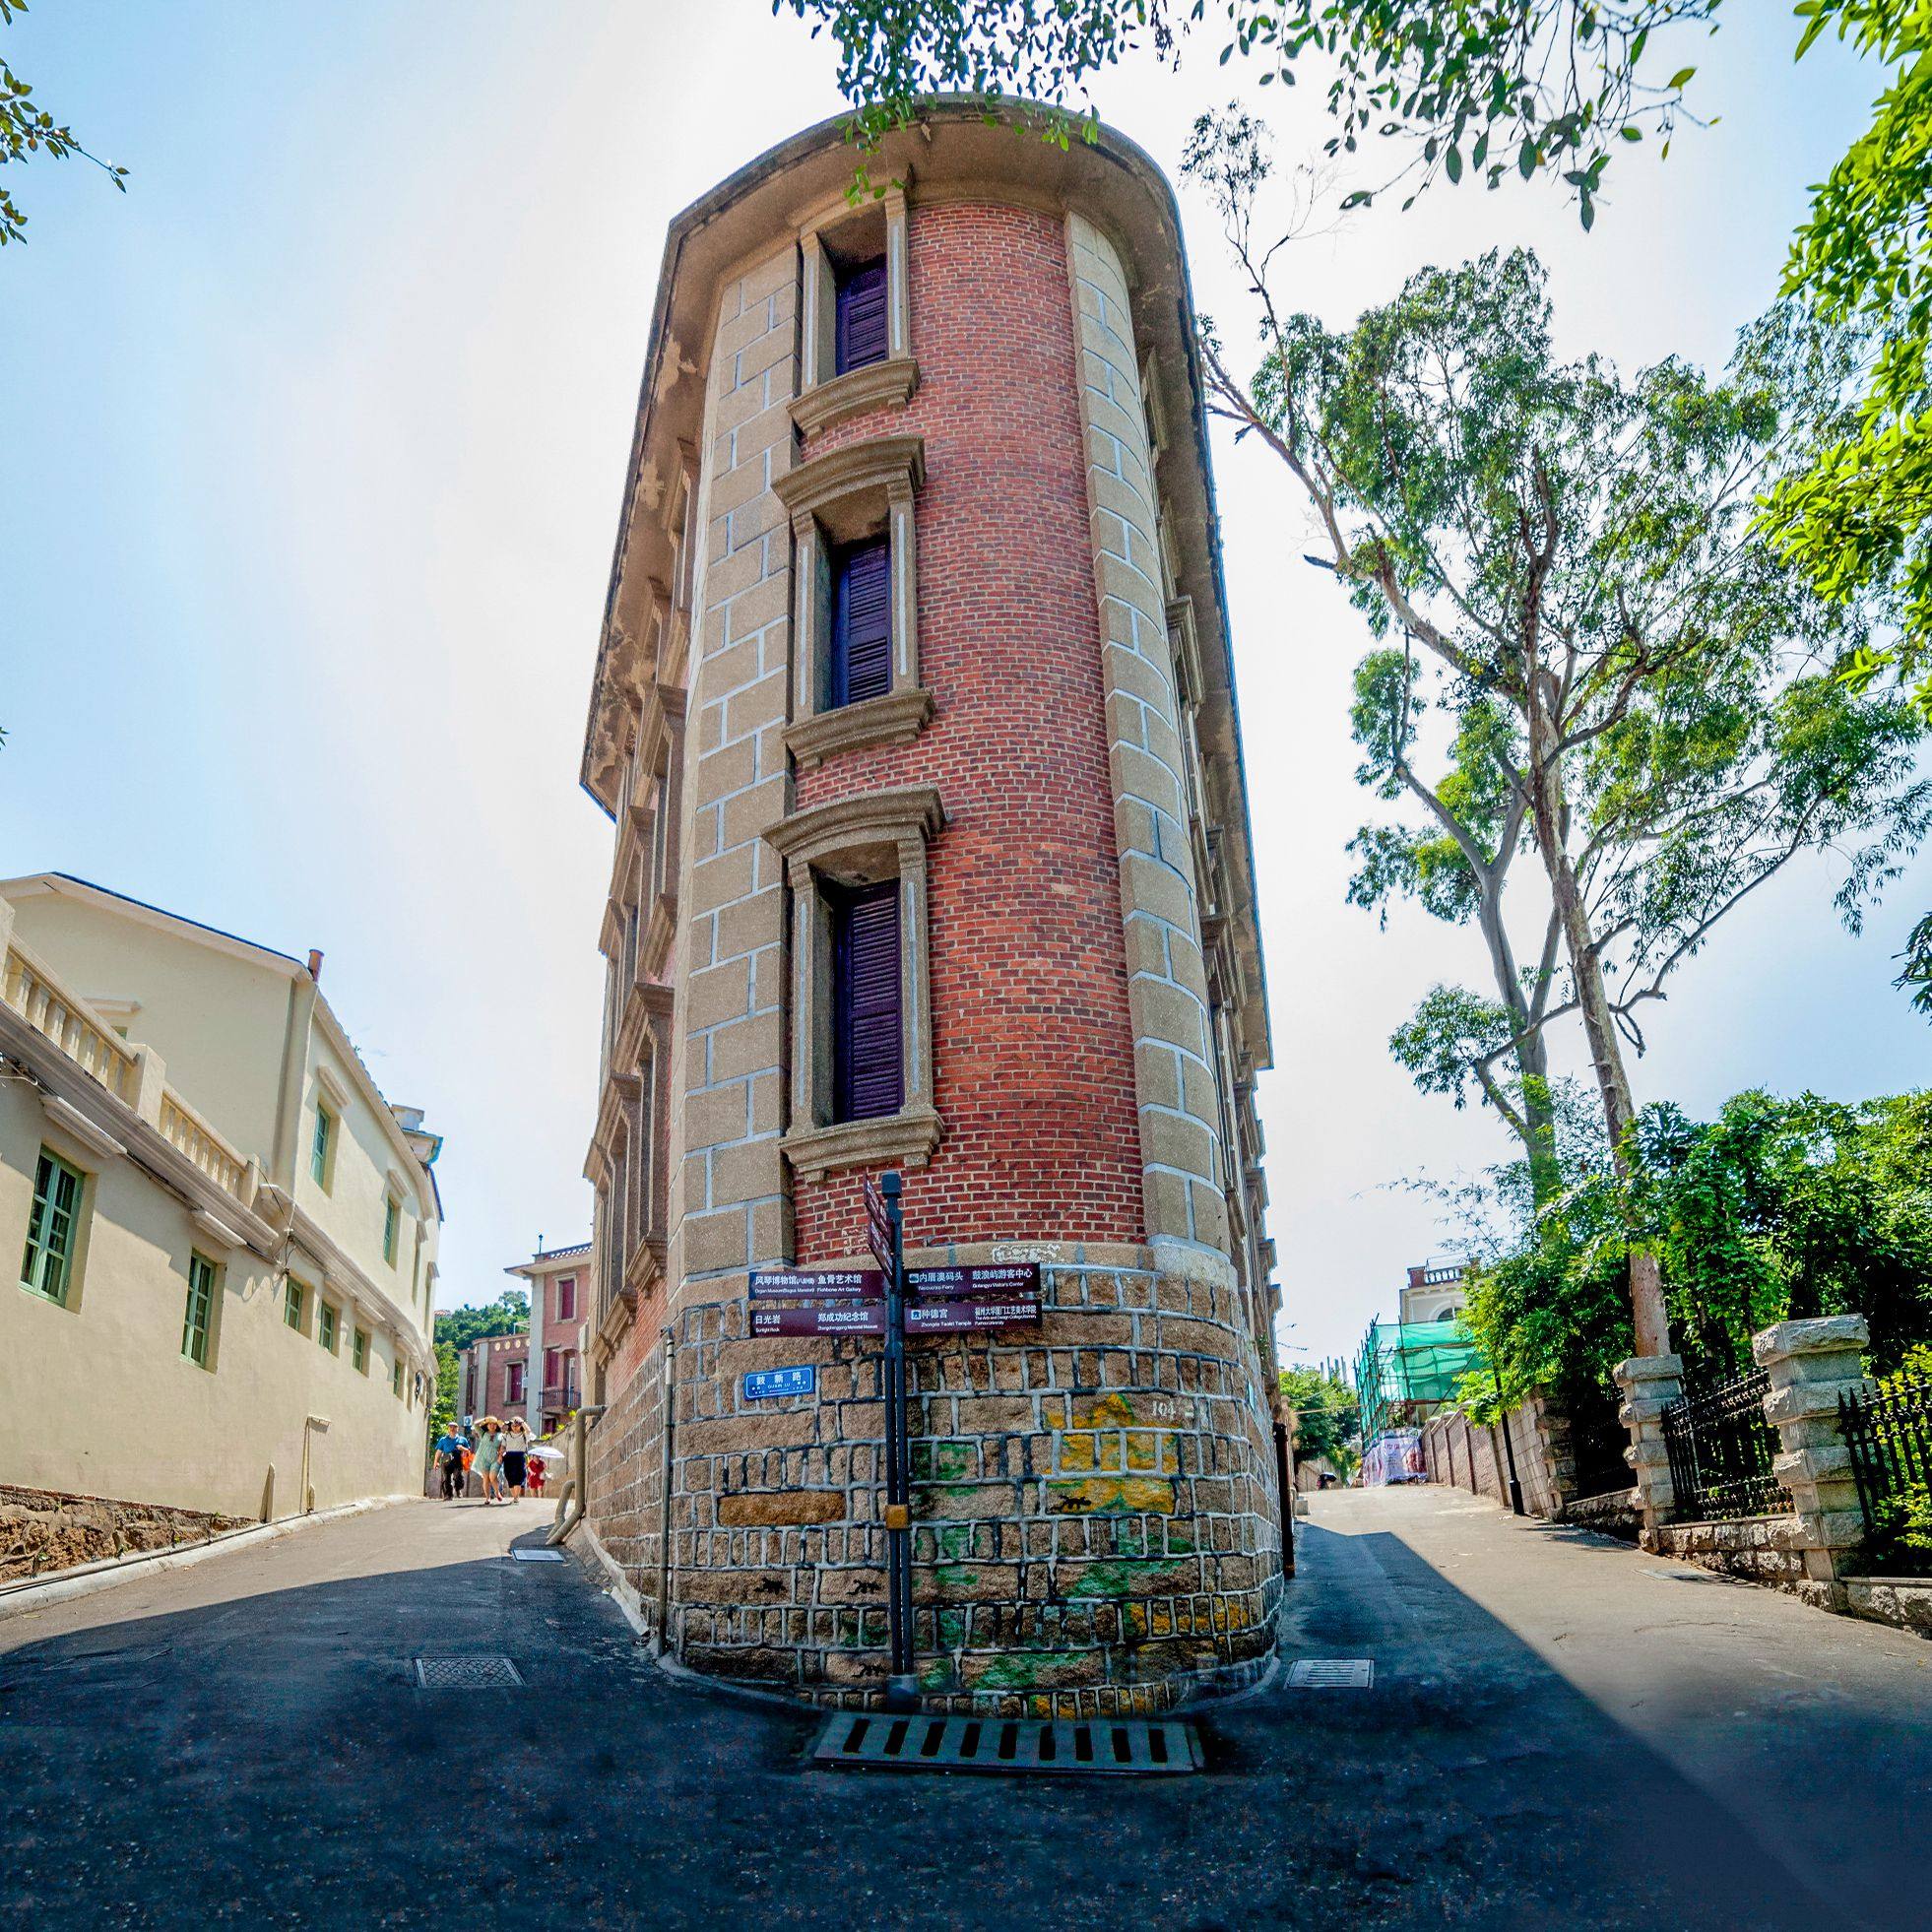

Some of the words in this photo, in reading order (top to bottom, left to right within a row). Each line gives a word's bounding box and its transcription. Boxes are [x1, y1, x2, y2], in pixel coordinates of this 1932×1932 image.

[817, 1274, 862, 1284] 鱼骨艺术馆
[972, 1268, 1033, 1280] 鼓浪屿游客中心
[755, 1315, 781, 1324] 日光岩
[817, 1312, 869, 1322] 郑成功纪念馆
